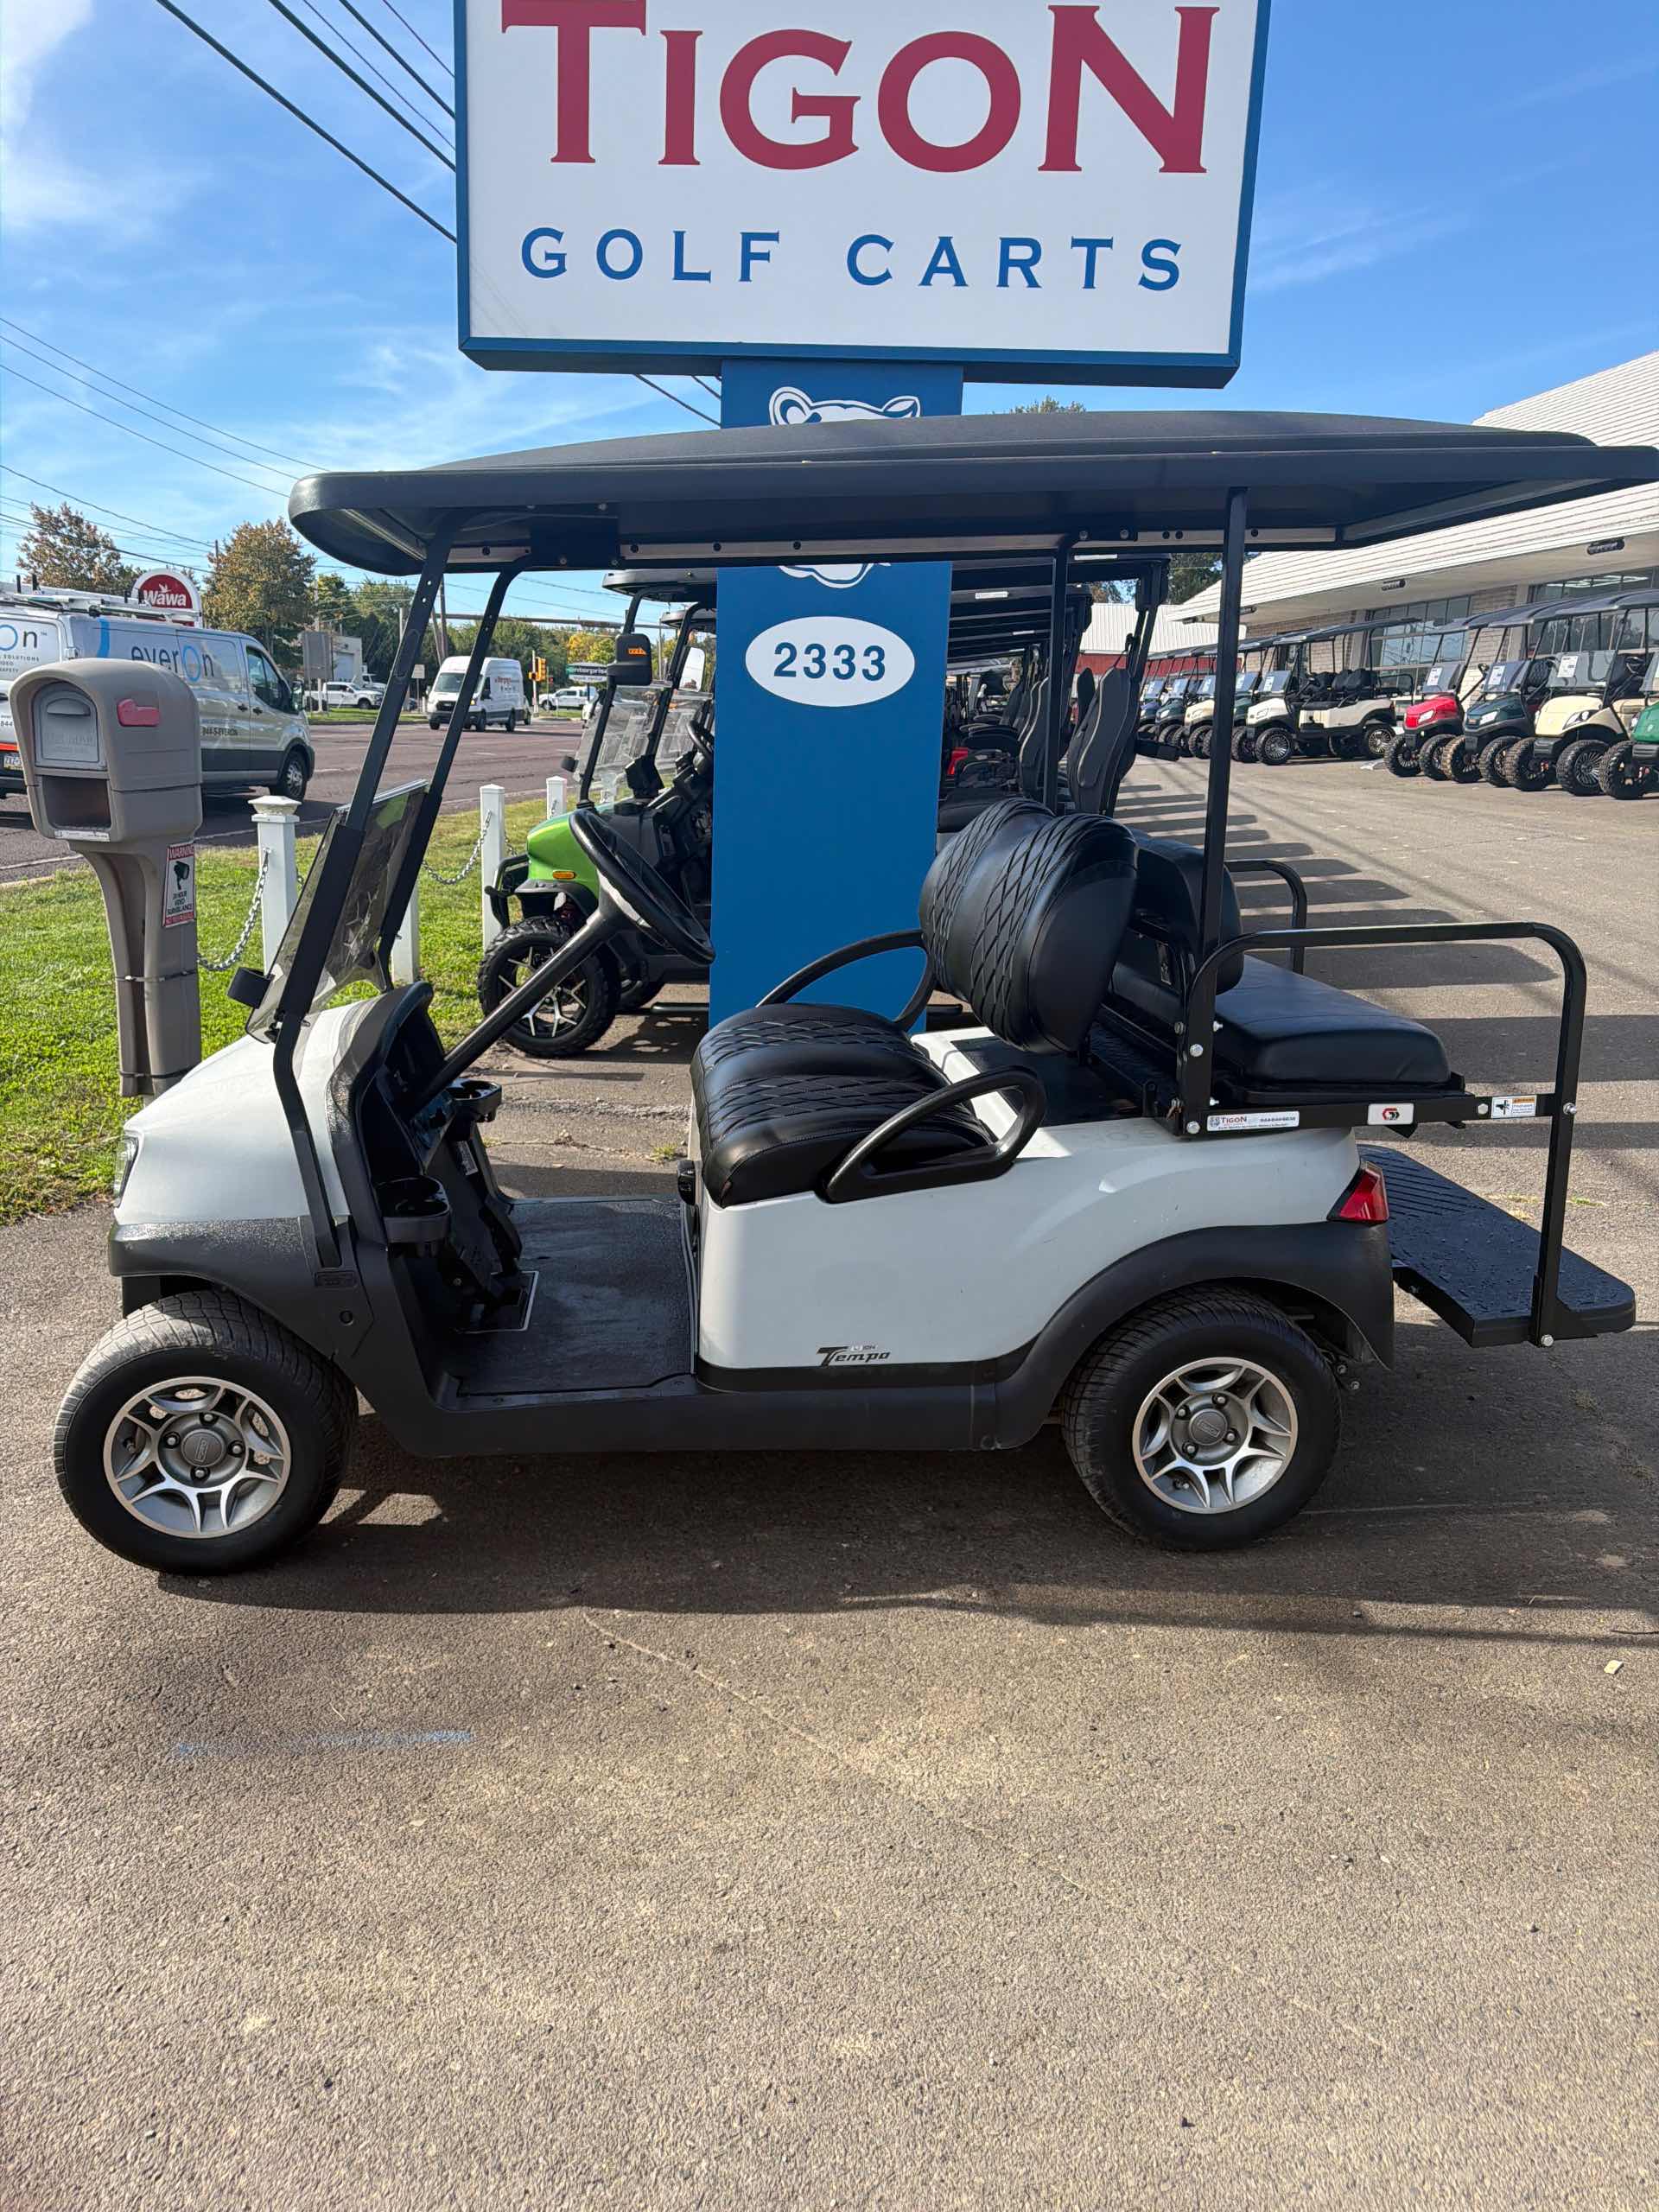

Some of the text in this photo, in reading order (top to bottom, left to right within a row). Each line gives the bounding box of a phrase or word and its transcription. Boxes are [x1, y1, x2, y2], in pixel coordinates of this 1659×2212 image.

[501, 0, 1220, 174] TIGON
[521, 226, 1181, 291] GOLF CARTS
[143, 589, 187, 607] Wawa
[773, 641, 886, 681] 2333
[816, 1345, 891, 1366] Tempo
